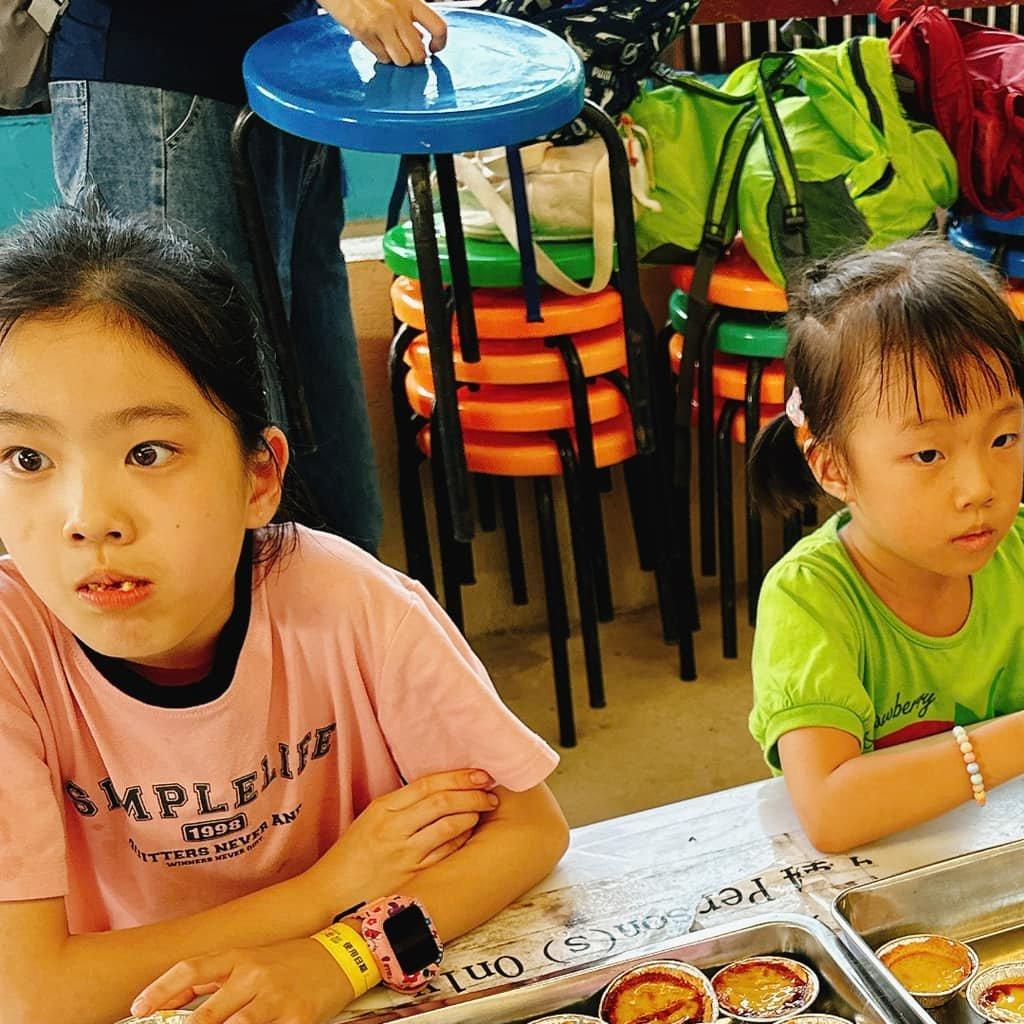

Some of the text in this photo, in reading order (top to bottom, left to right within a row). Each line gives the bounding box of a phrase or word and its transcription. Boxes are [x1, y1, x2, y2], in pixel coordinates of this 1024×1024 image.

[189, 819, 242, 840] 1998
[214, 821, 268, 854] NEVER
[543, 877, 777, 963] Person(s)
